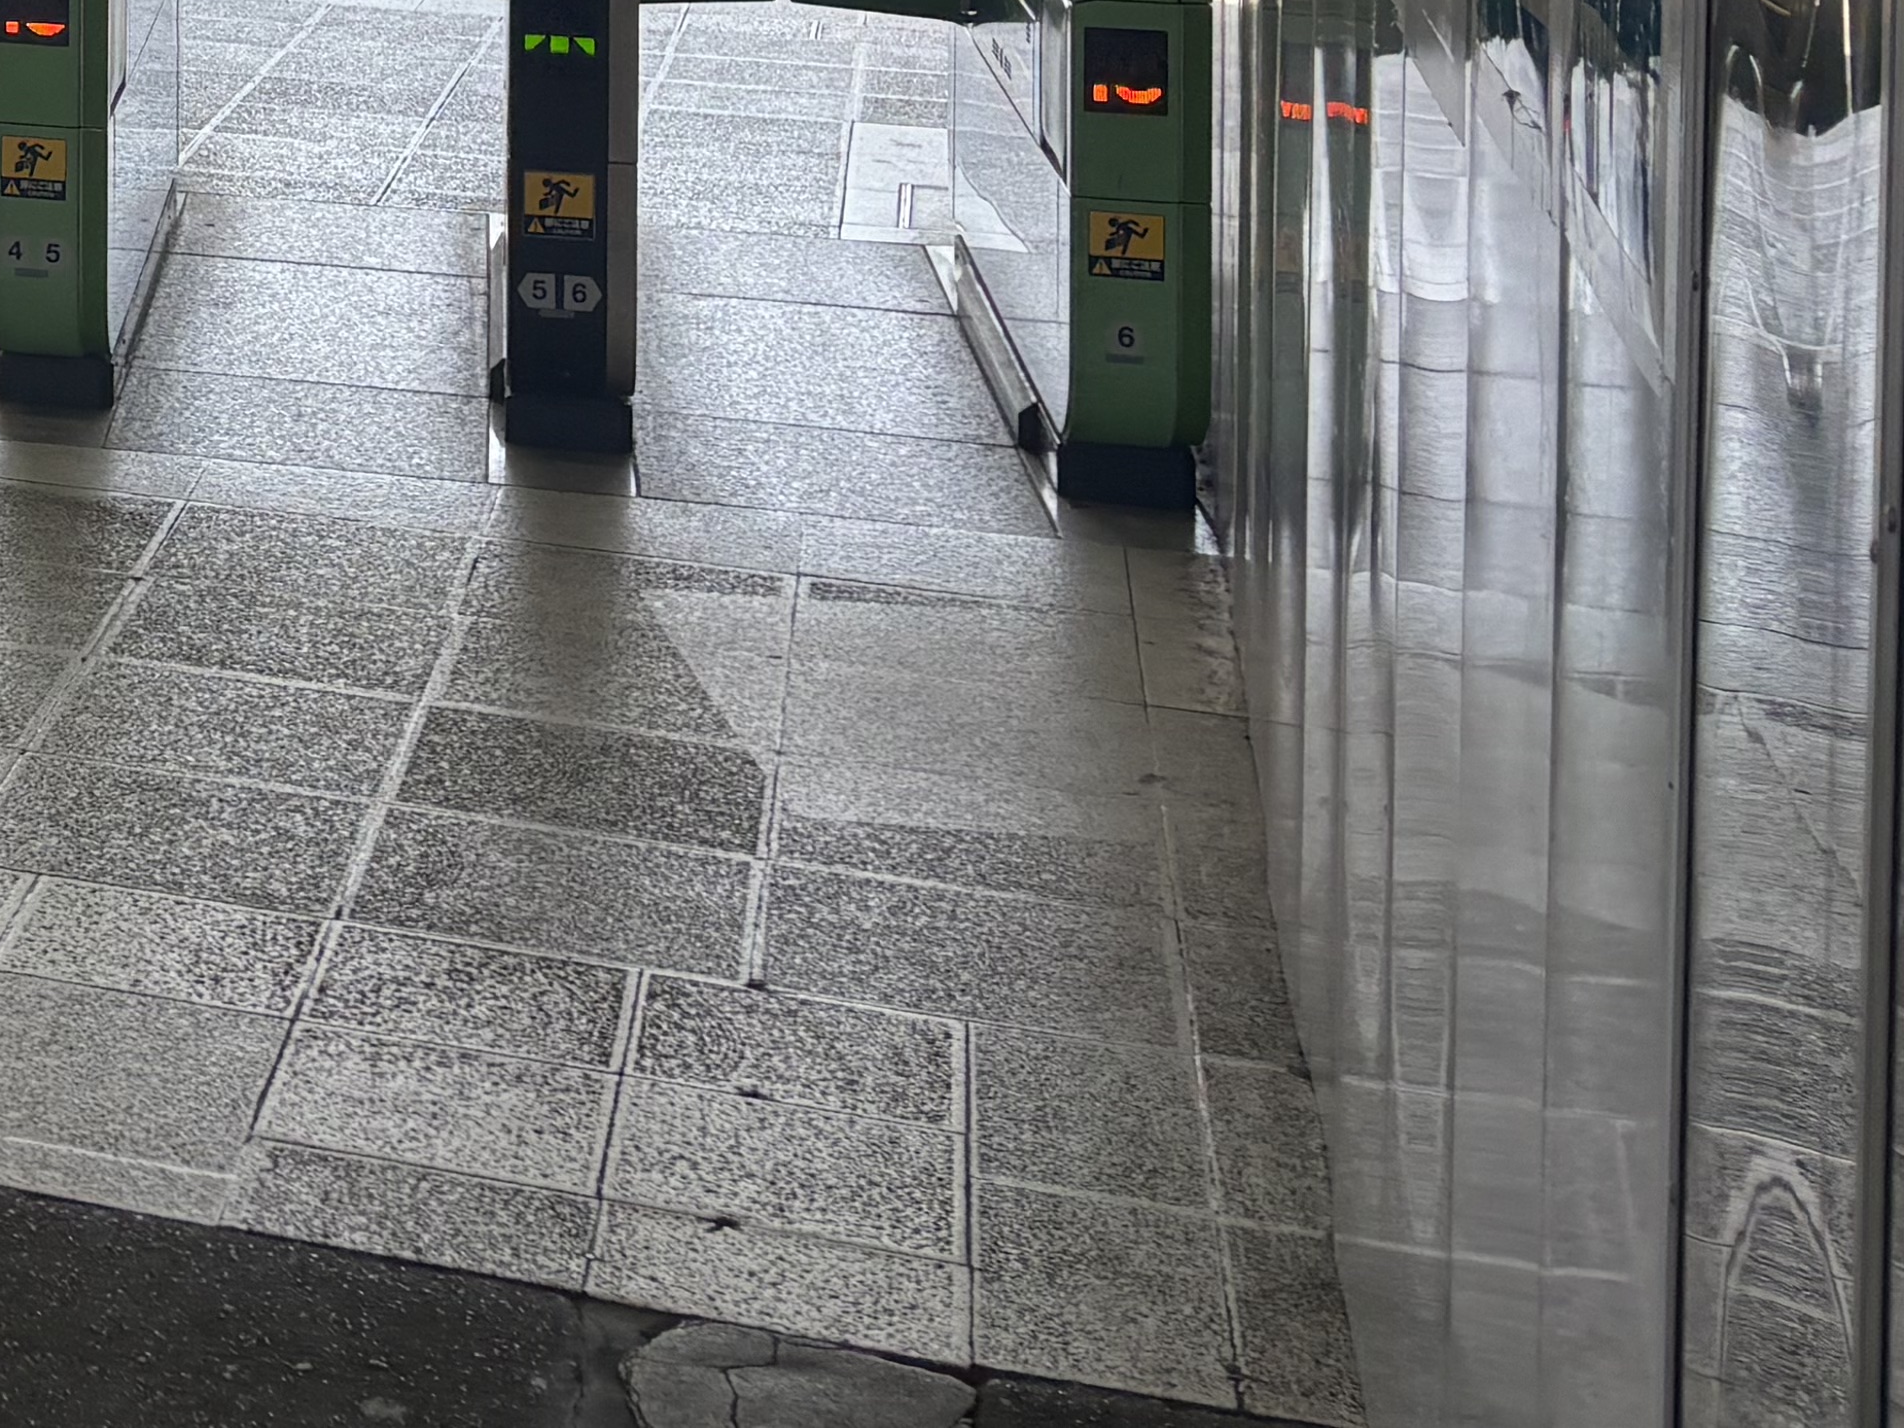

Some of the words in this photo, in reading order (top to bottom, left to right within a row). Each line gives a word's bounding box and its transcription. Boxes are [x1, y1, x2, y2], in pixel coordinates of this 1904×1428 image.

[8, 241, 24, 262] 4
[45, 243, 61, 264] 5
[531, 280, 547, 301] 5
[572, 283, 588, 304] 6
[1117, 325, 1135, 348] 6
